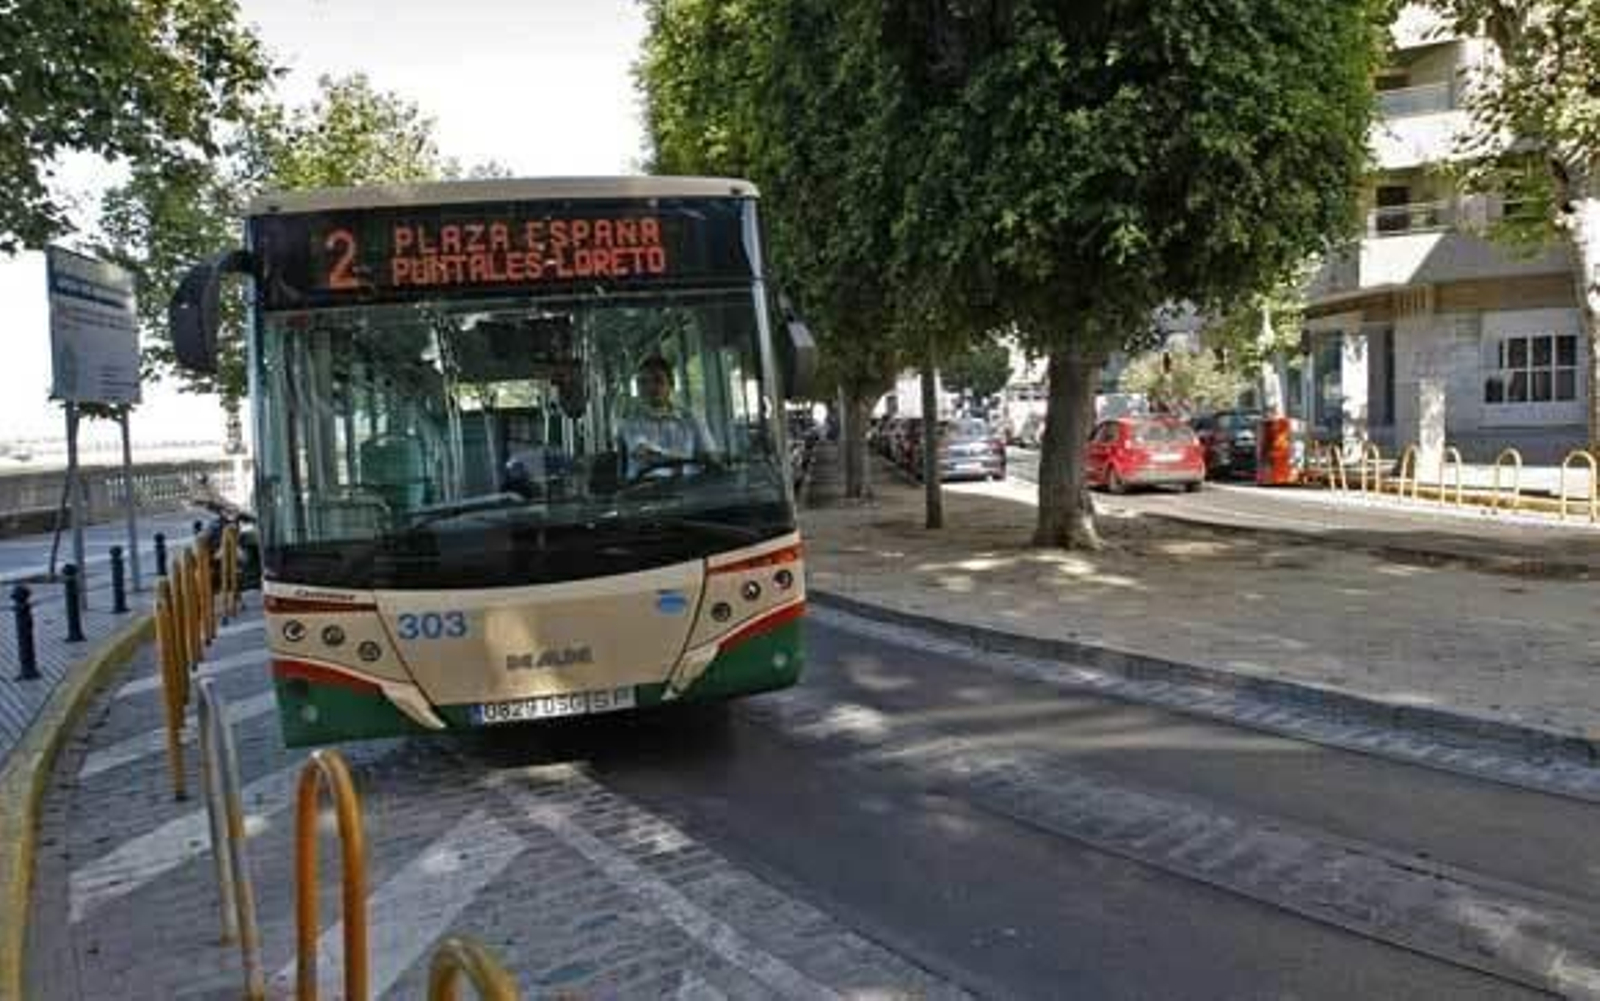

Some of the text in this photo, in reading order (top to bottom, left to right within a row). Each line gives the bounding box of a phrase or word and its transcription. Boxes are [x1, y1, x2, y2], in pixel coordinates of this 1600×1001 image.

[395, 222, 508, 254] PLAZA
[326, 230, 358, 289] 2
[398, 609, 467, 639] 303
